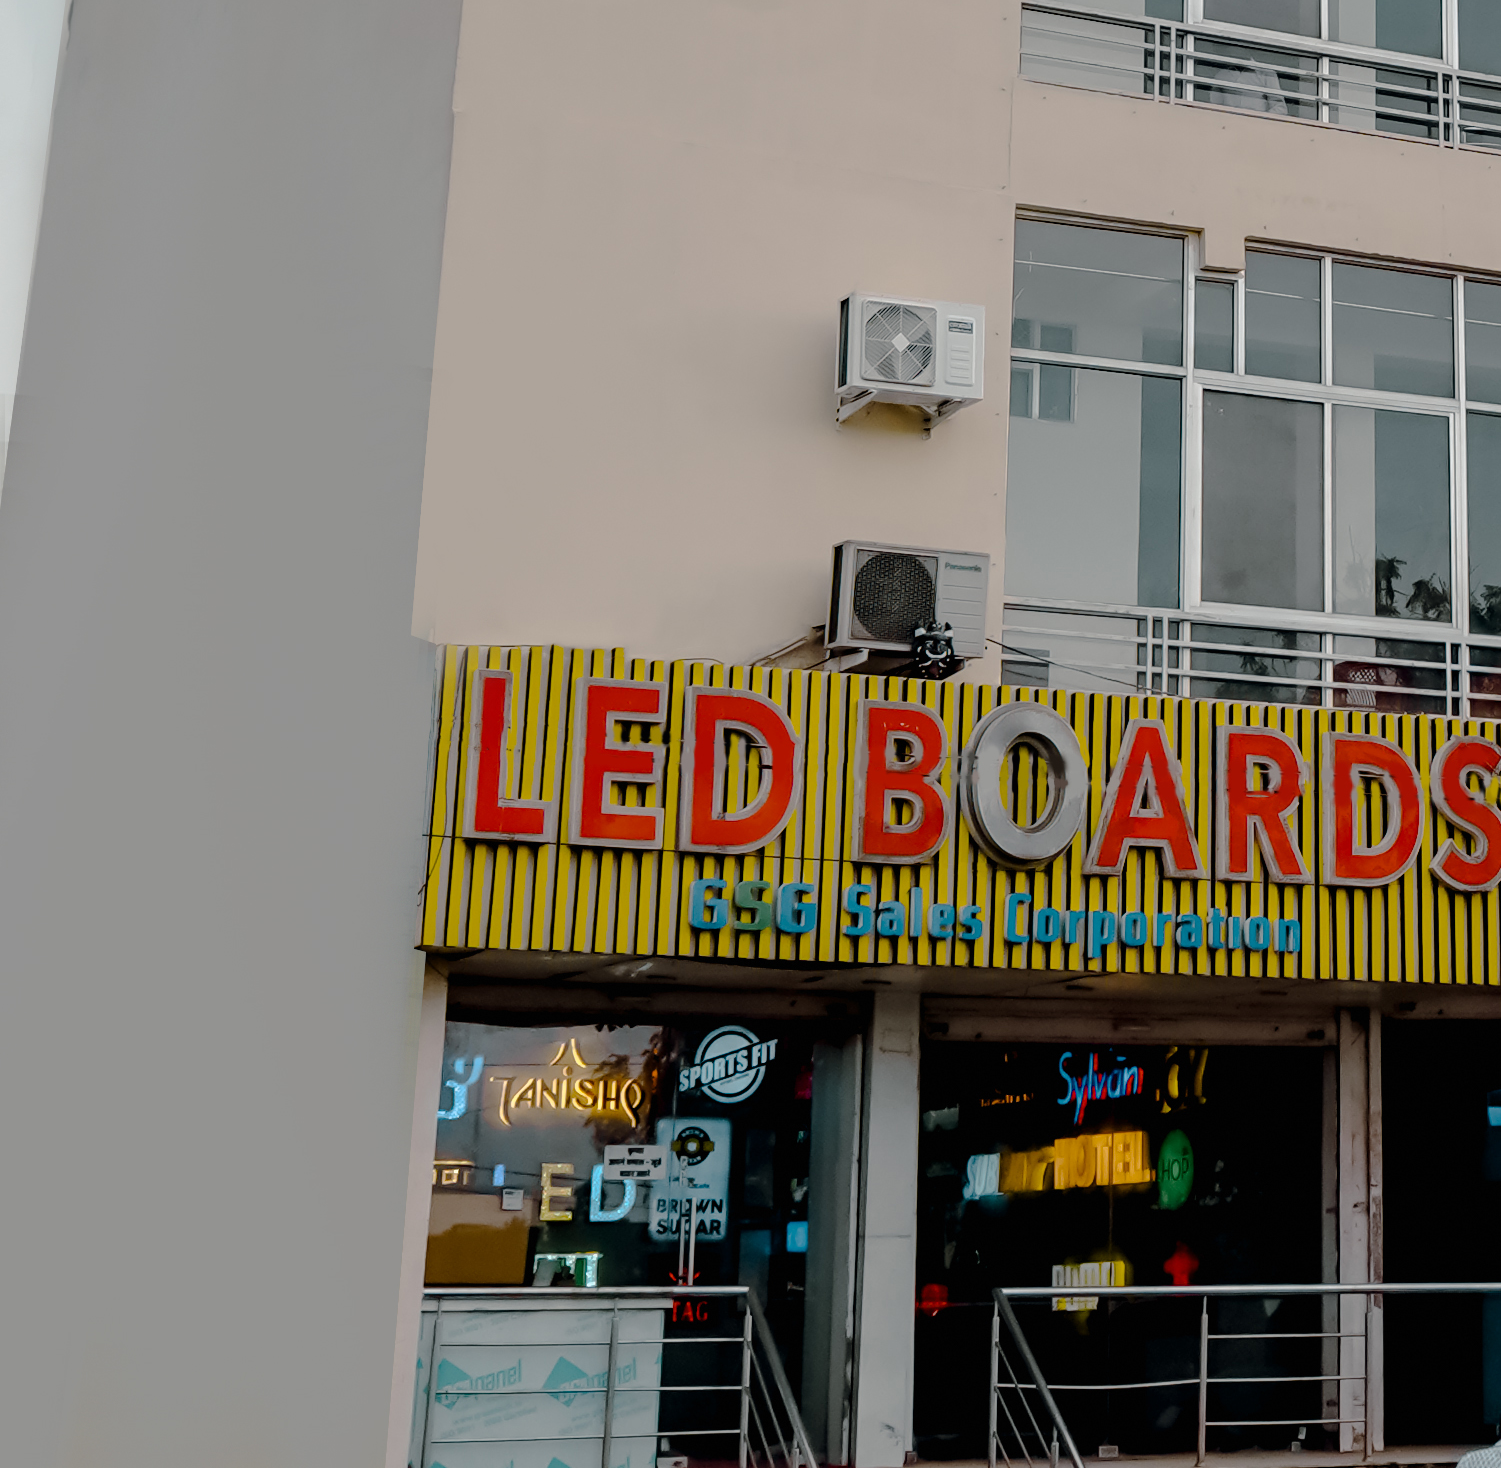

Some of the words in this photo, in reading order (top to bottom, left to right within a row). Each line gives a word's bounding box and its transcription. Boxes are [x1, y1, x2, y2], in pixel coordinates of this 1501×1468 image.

[462, 668, 801, 854] LED
[688, 878, 817, 934] GSG
[842, 883, 983, 941] Sales
[1004, 892, 1301, 960] Corporation
[678, 1049, 749, 1092] SPORTS
[751, 1038, 779, 1068] FIT
